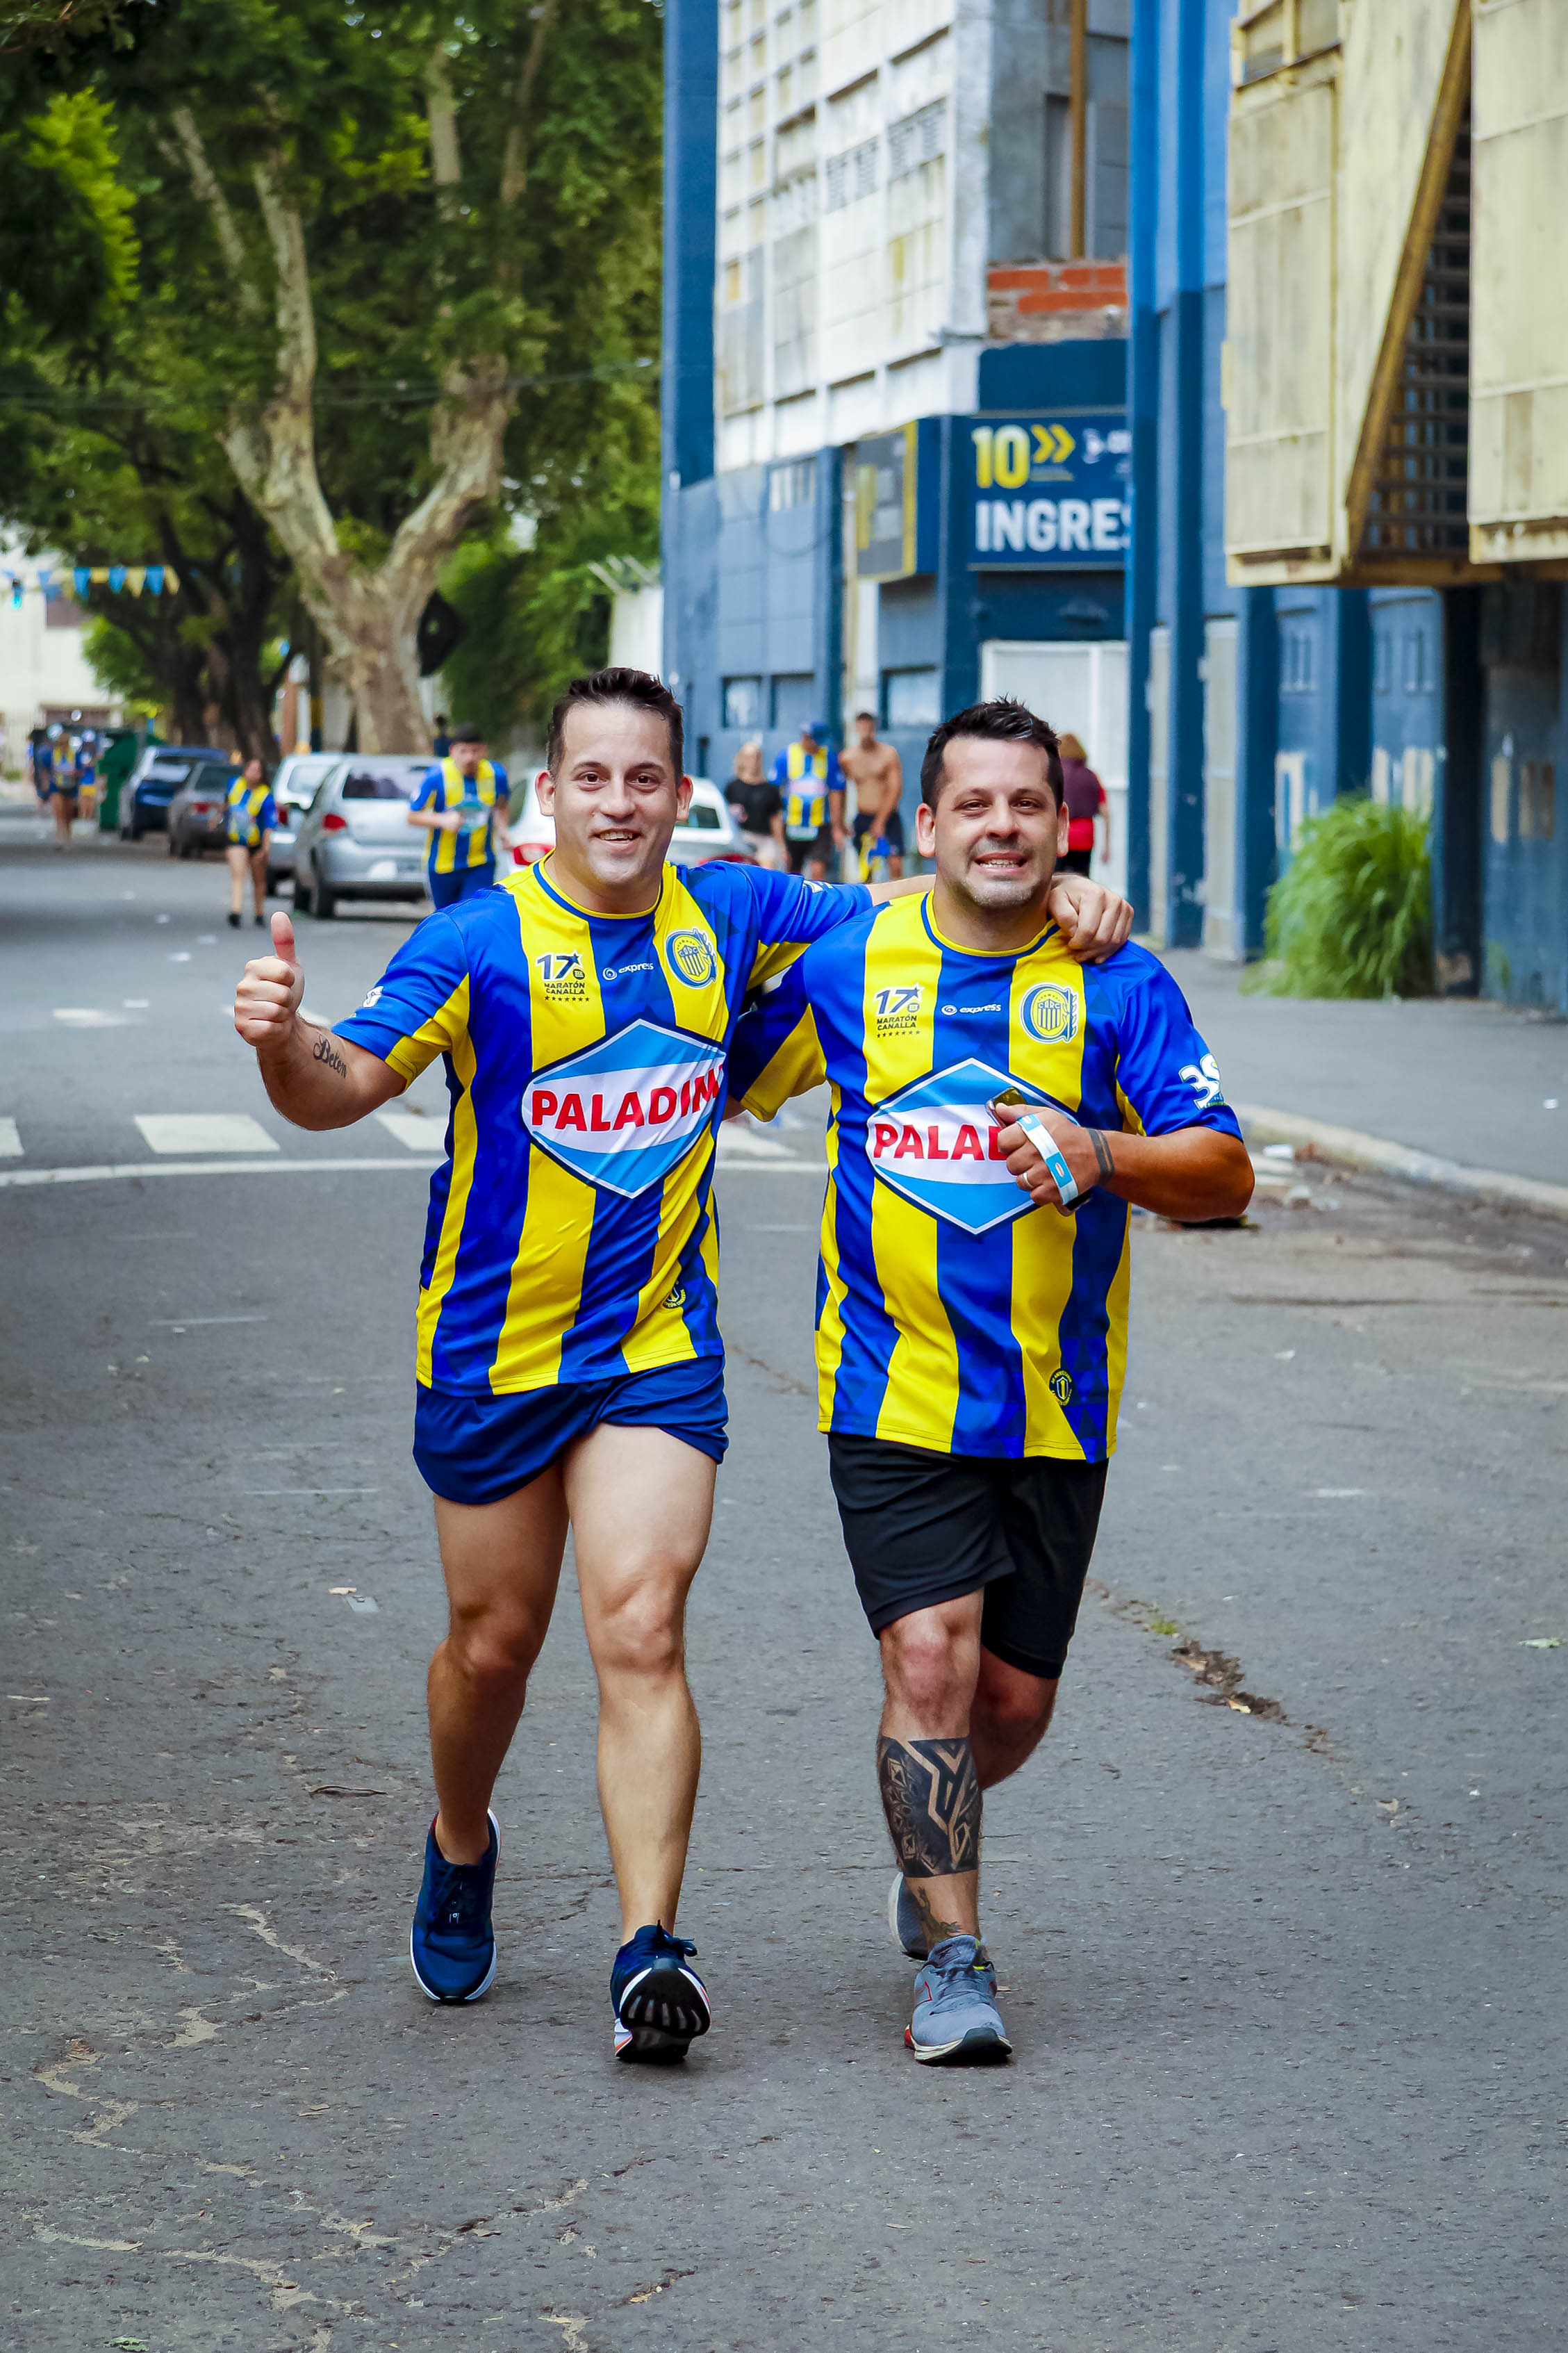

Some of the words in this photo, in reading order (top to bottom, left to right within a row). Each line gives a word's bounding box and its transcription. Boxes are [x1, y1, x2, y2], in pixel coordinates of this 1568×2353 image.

[971, 425, 1030, 489] 10
[536, 950, 583, 981] 17
[618, 962, 654, 973] express
[874, 984, 923, 1015] 17
[959, 1003, 1001, 1014] express
[877, 1014, 917, 1024] MARATÓN
[877, 1022, 916, 1031] CANALLA
[532, 1063, 723, 1131] PALADIN
